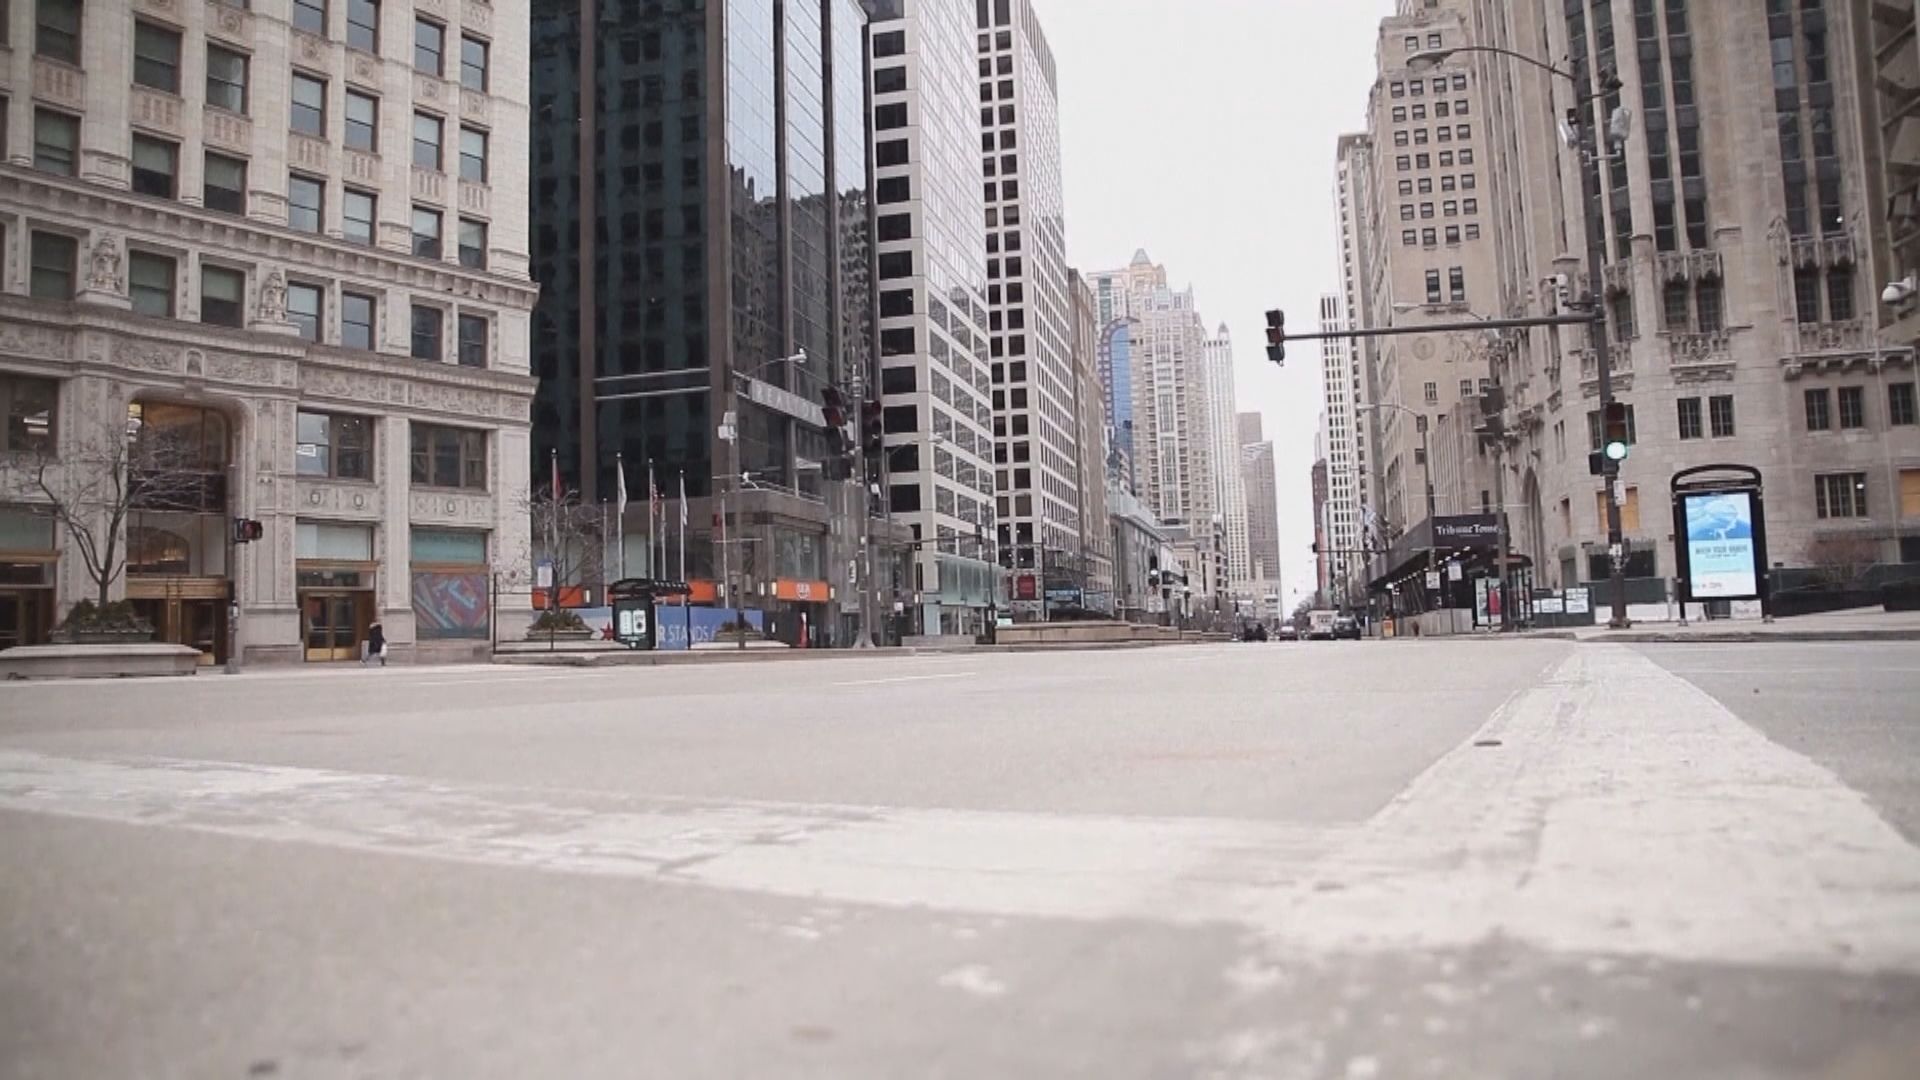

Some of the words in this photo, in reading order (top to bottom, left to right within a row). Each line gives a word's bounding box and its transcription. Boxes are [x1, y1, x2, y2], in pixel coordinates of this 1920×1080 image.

[1435, 524, 1472, 535] Tribune
[1473, 523, 1499, 534] Tower
[667, 624, 708, 642] STANDS
